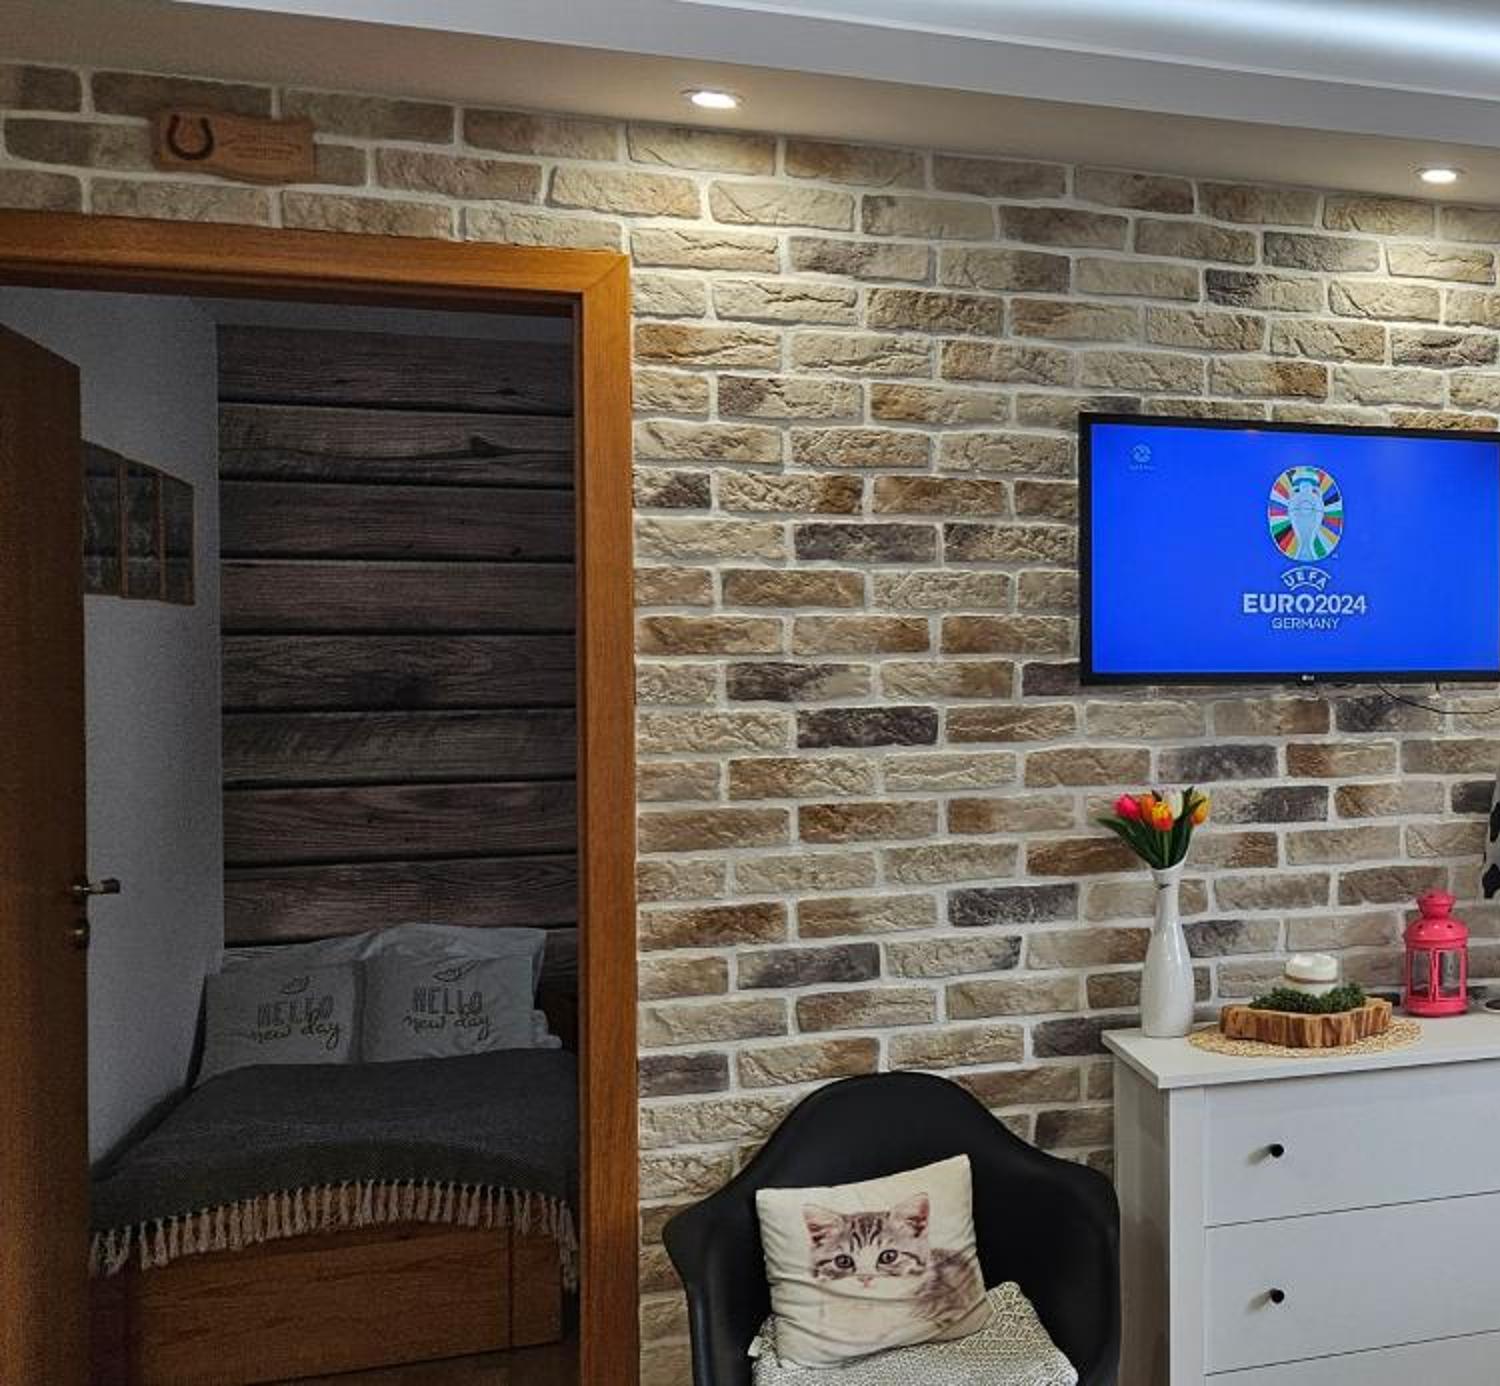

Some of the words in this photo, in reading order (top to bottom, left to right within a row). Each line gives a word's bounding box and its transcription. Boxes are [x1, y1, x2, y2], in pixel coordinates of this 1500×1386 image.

[1283, 571, 1327, 588] UEFA
[1272, 617, 1341, 629] GERMANY
[257, 994, 335, 1026] HELLO
[414, 987, 483, 1014] HELLO
[301, 1008, 340, 1050] day
[455, 1003, 490, 1041] day
